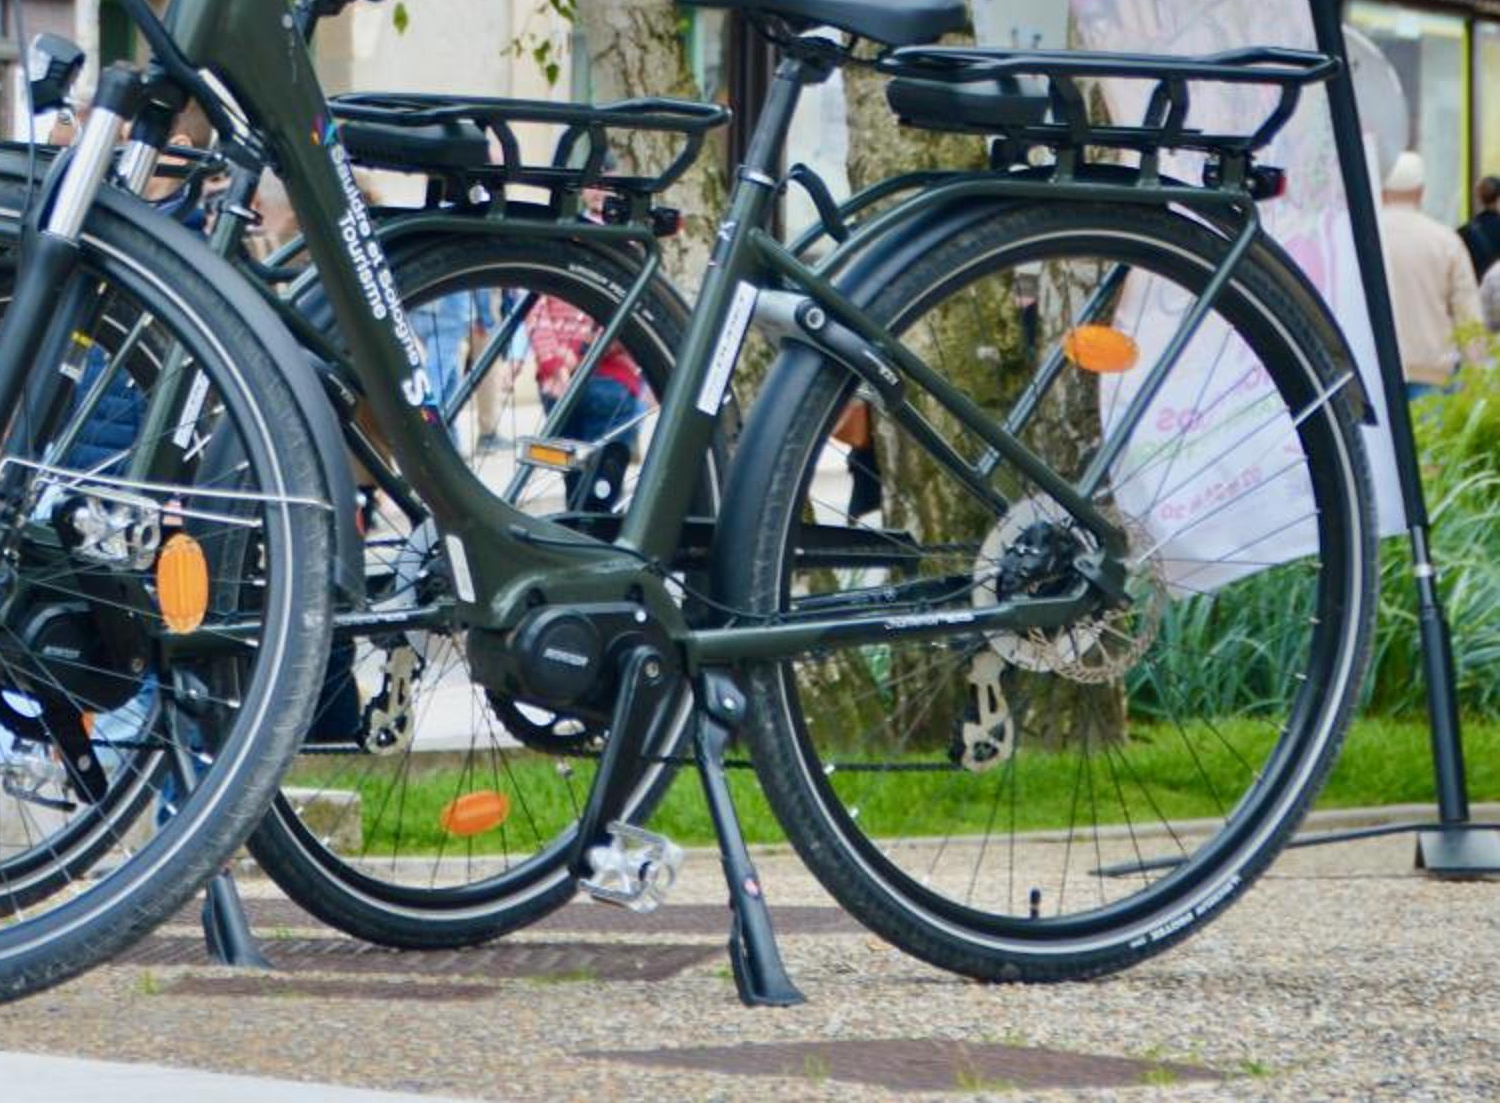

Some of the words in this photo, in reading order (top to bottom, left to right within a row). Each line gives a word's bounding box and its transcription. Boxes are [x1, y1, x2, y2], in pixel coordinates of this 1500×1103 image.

[331, 146, 372, 237] Sauldre
[367, 240, 384, 267] et
[378, 268, 420, 366] Sologne
[338, 211, 388, 320] Tourisme
